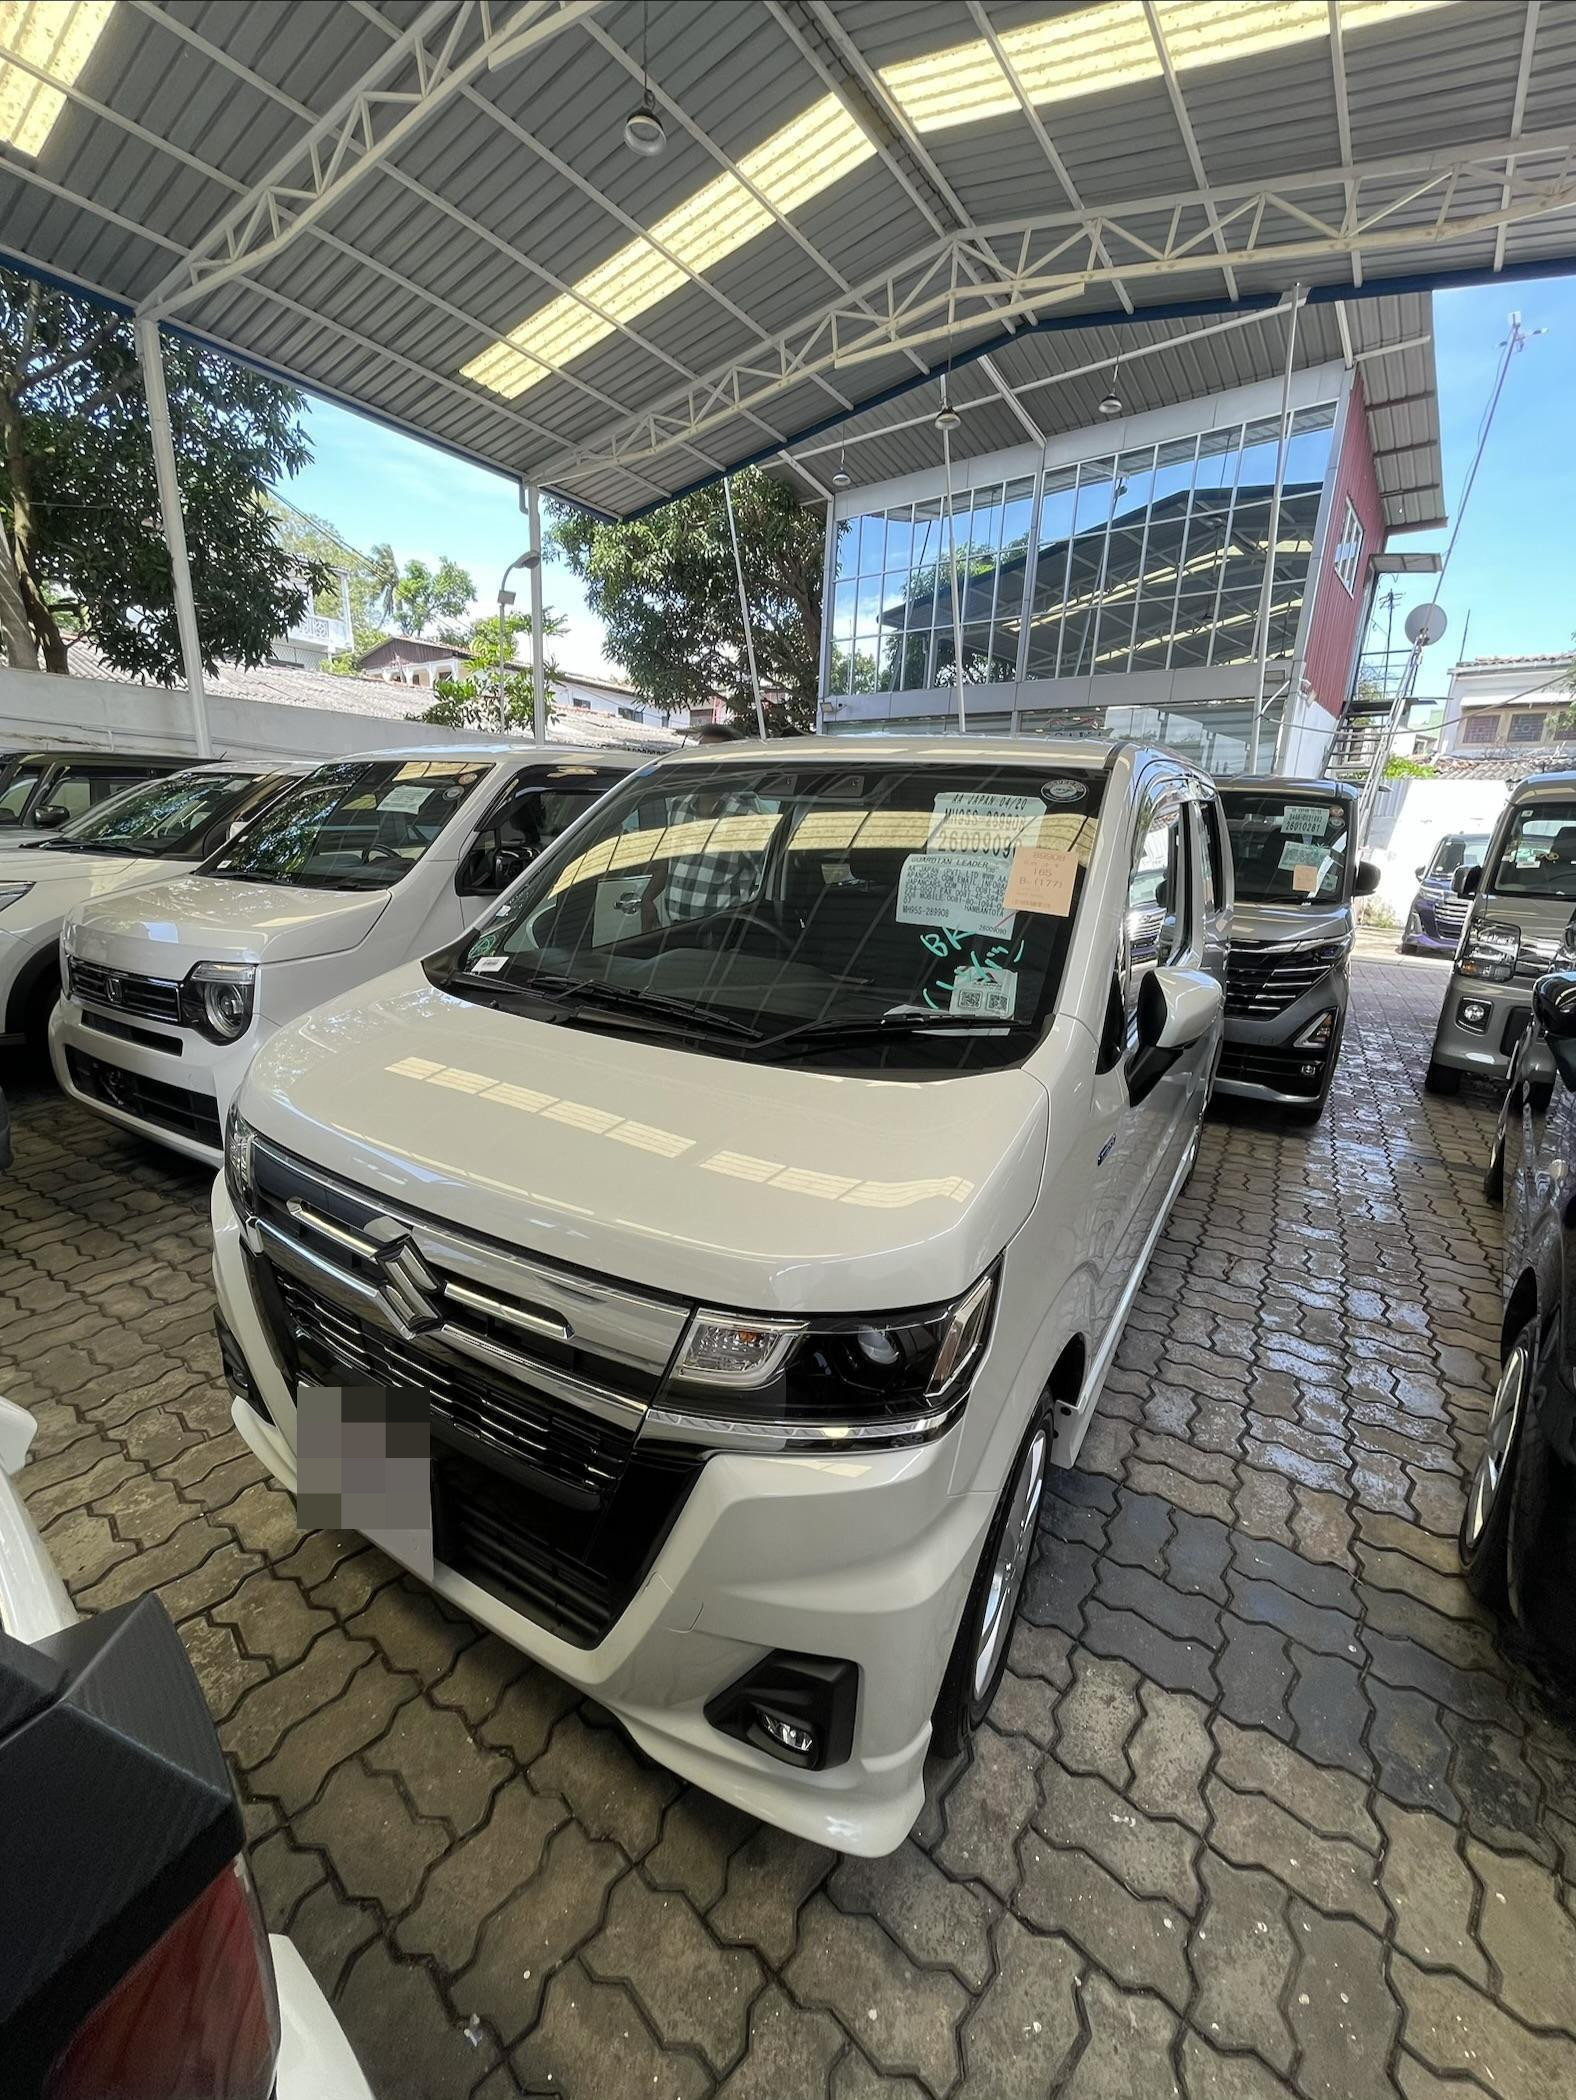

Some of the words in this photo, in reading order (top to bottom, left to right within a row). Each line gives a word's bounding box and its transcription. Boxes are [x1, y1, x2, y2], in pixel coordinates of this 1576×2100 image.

[967, 794, 996, 805] JAPAN
[910, 856, 952, 865] GUARDIAN
[956, 860, 988, 868] LEADER
